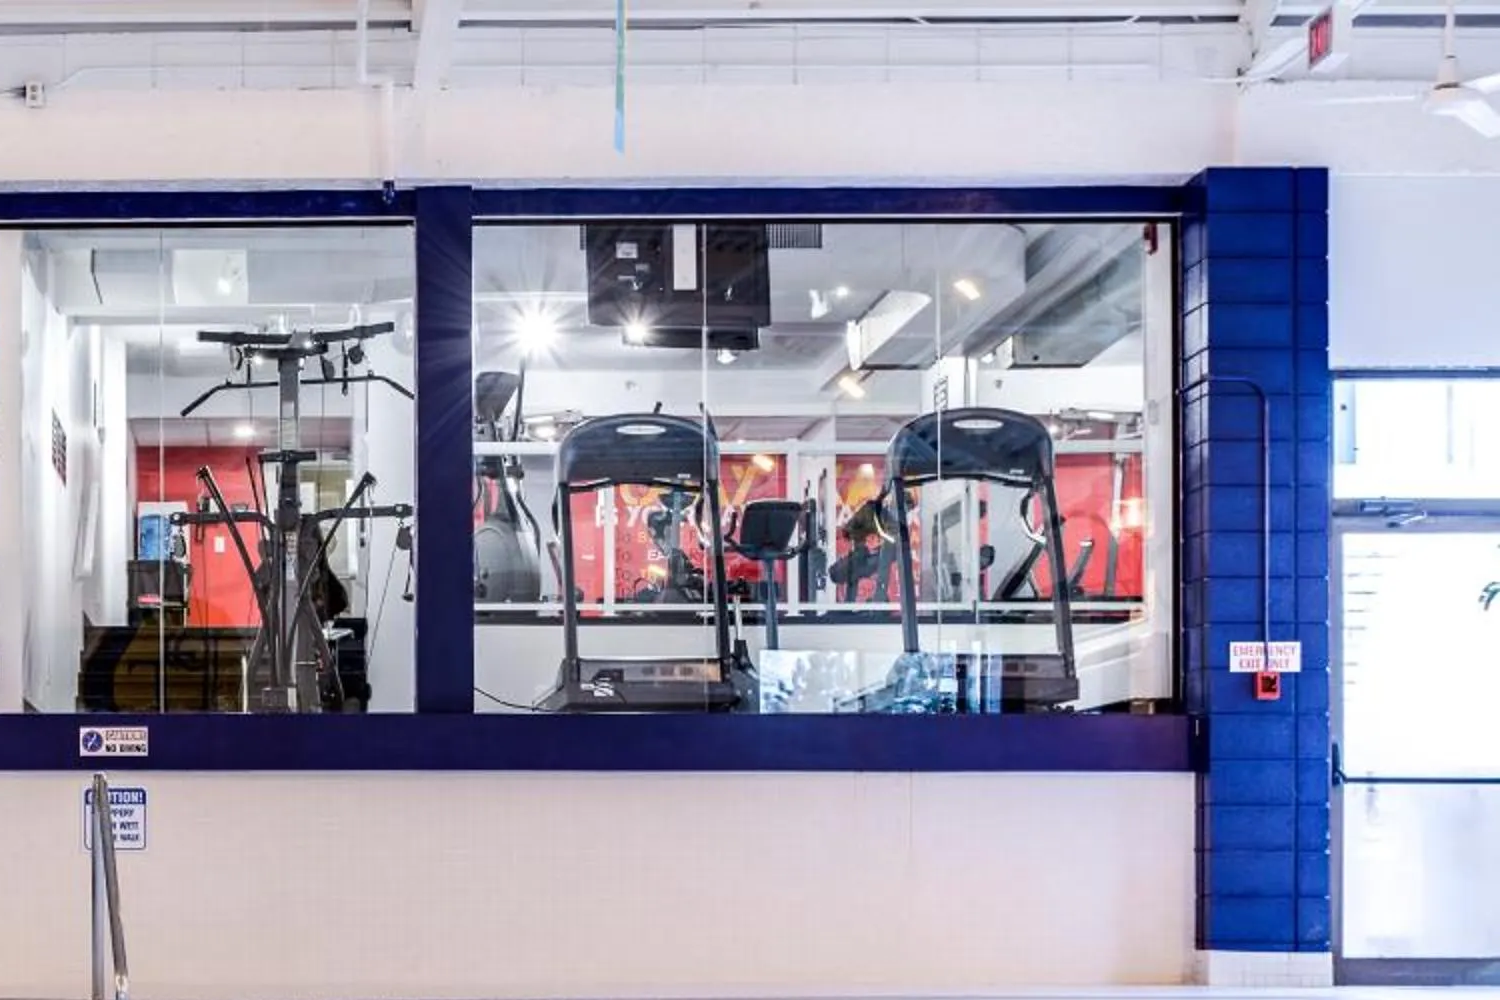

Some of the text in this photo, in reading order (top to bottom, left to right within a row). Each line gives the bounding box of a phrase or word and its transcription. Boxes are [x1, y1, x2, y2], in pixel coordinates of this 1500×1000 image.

[1233, 645, 1296, 657] EMERENCY
[105, 744, 147, 752] NO DIVING
[88, 791, 143, 803] CTION!
